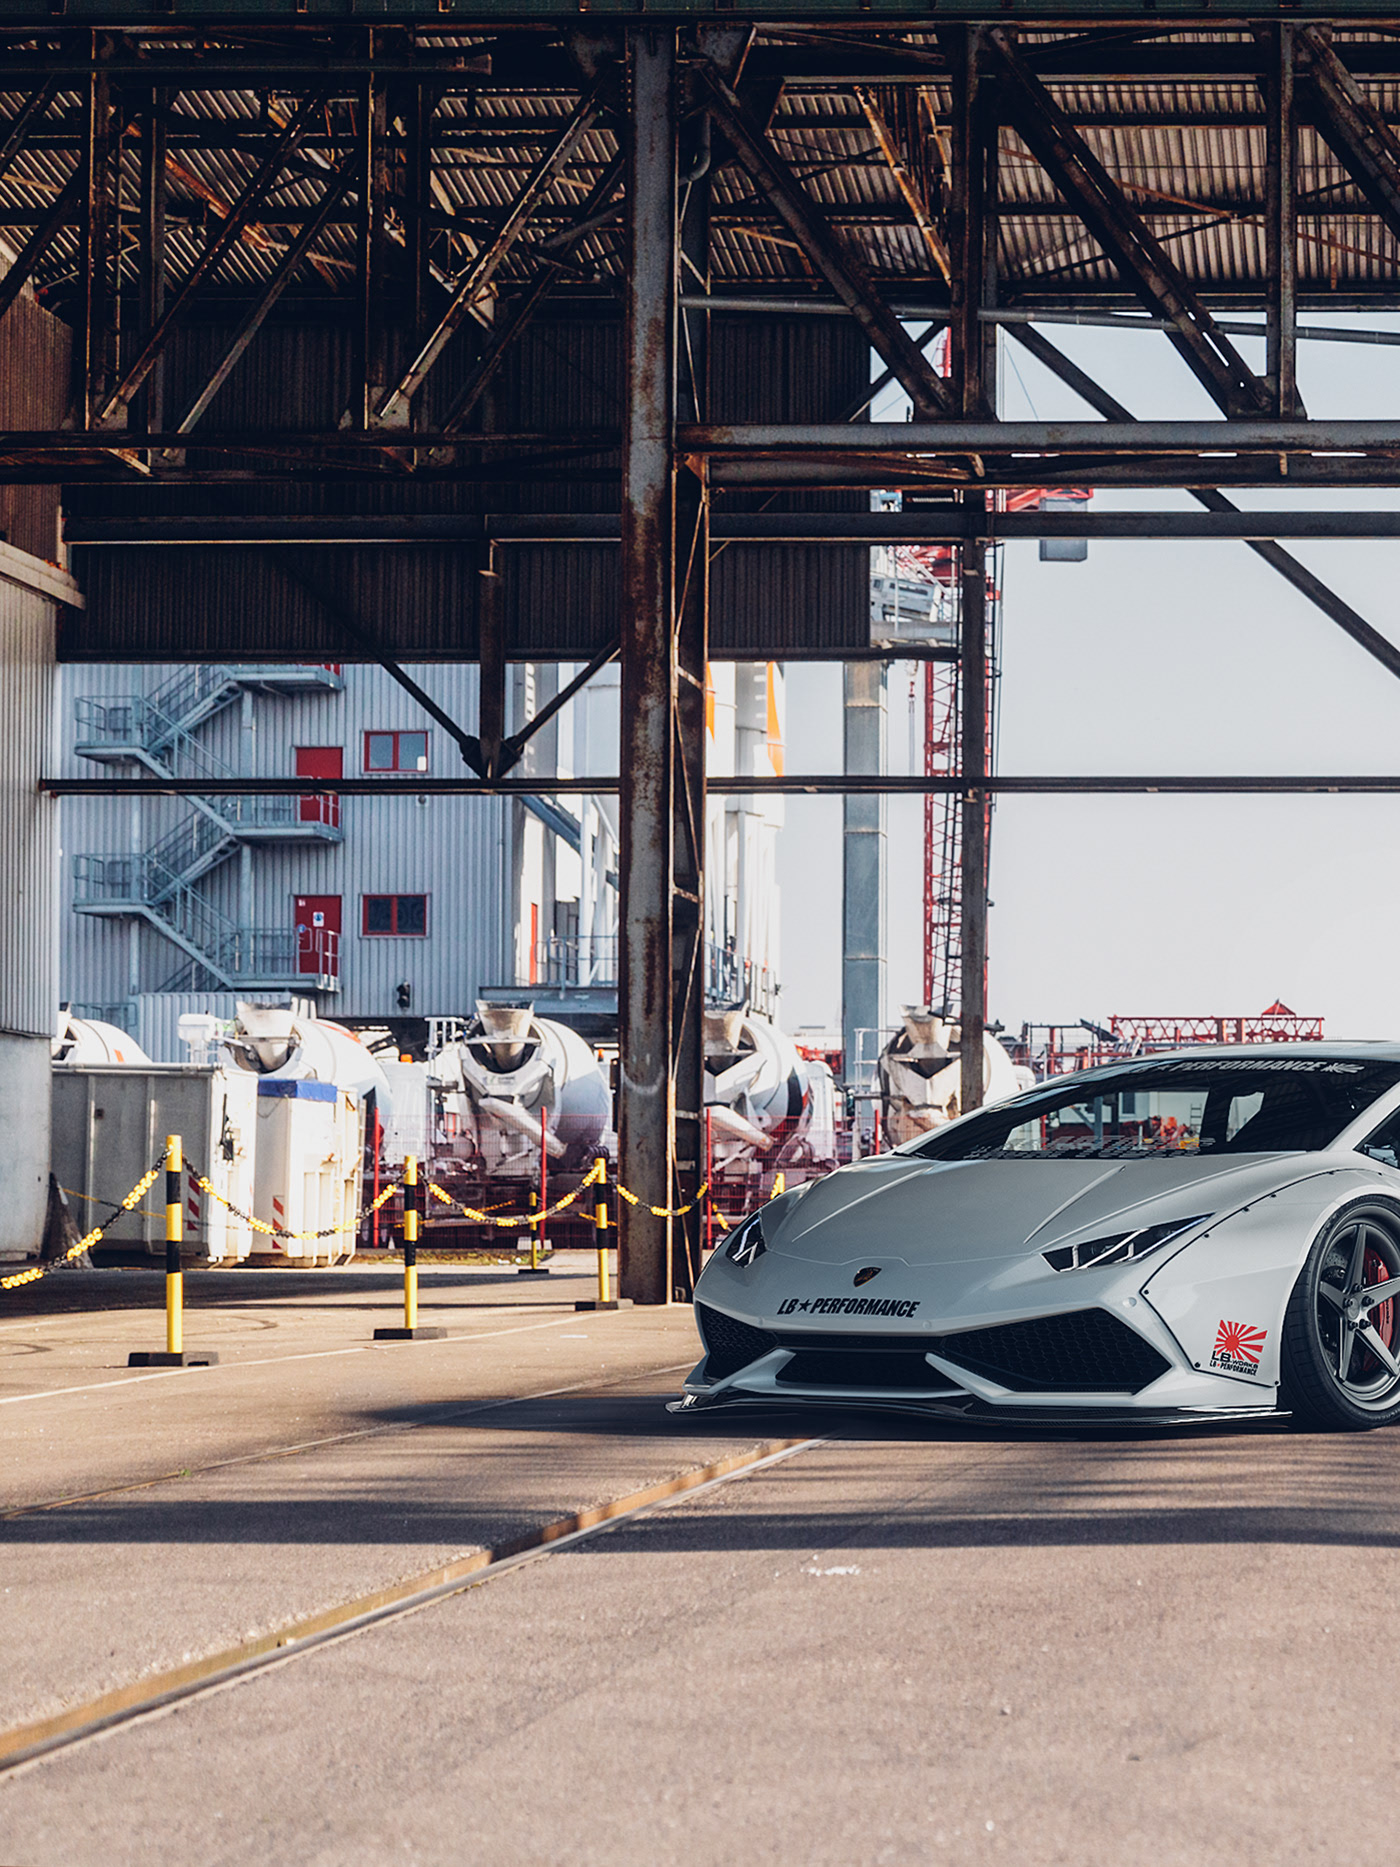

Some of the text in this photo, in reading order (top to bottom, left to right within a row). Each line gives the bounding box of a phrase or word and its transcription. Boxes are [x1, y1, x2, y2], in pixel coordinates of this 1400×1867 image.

[1169, 1061, 1326, 1072] PERFORMANCE
[776, 1297, 921, 1318] LB PERFORMANCE
